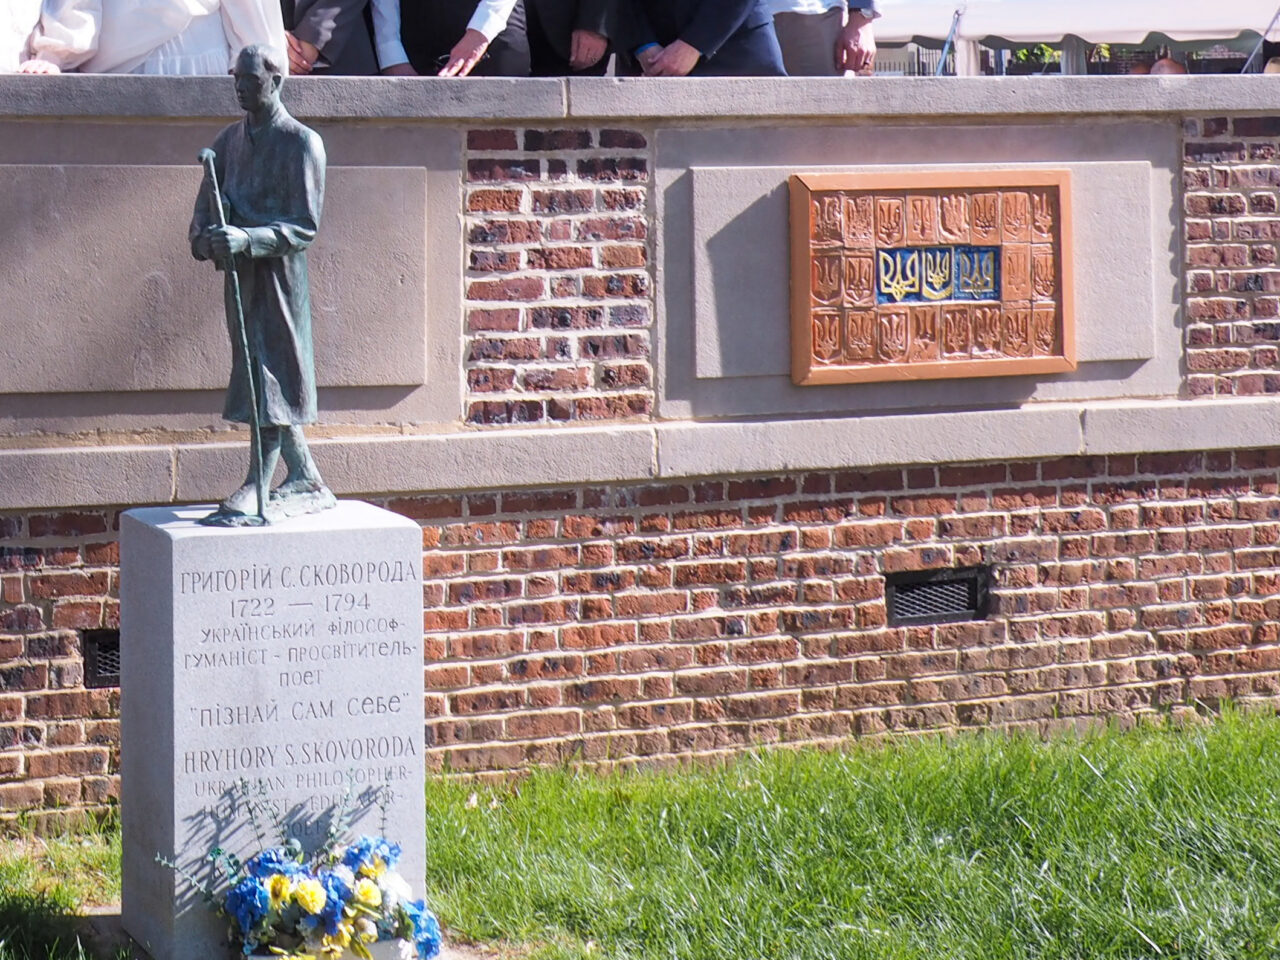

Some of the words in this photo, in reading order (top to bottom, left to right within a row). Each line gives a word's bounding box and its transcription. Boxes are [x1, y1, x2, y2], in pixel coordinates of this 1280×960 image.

[231, 597, 275, 619] 1722
[324, 592, 371, 613] 1794
[291, 699, 334, 721] САМ
[183, 744, 278, 775] HRYHORY
